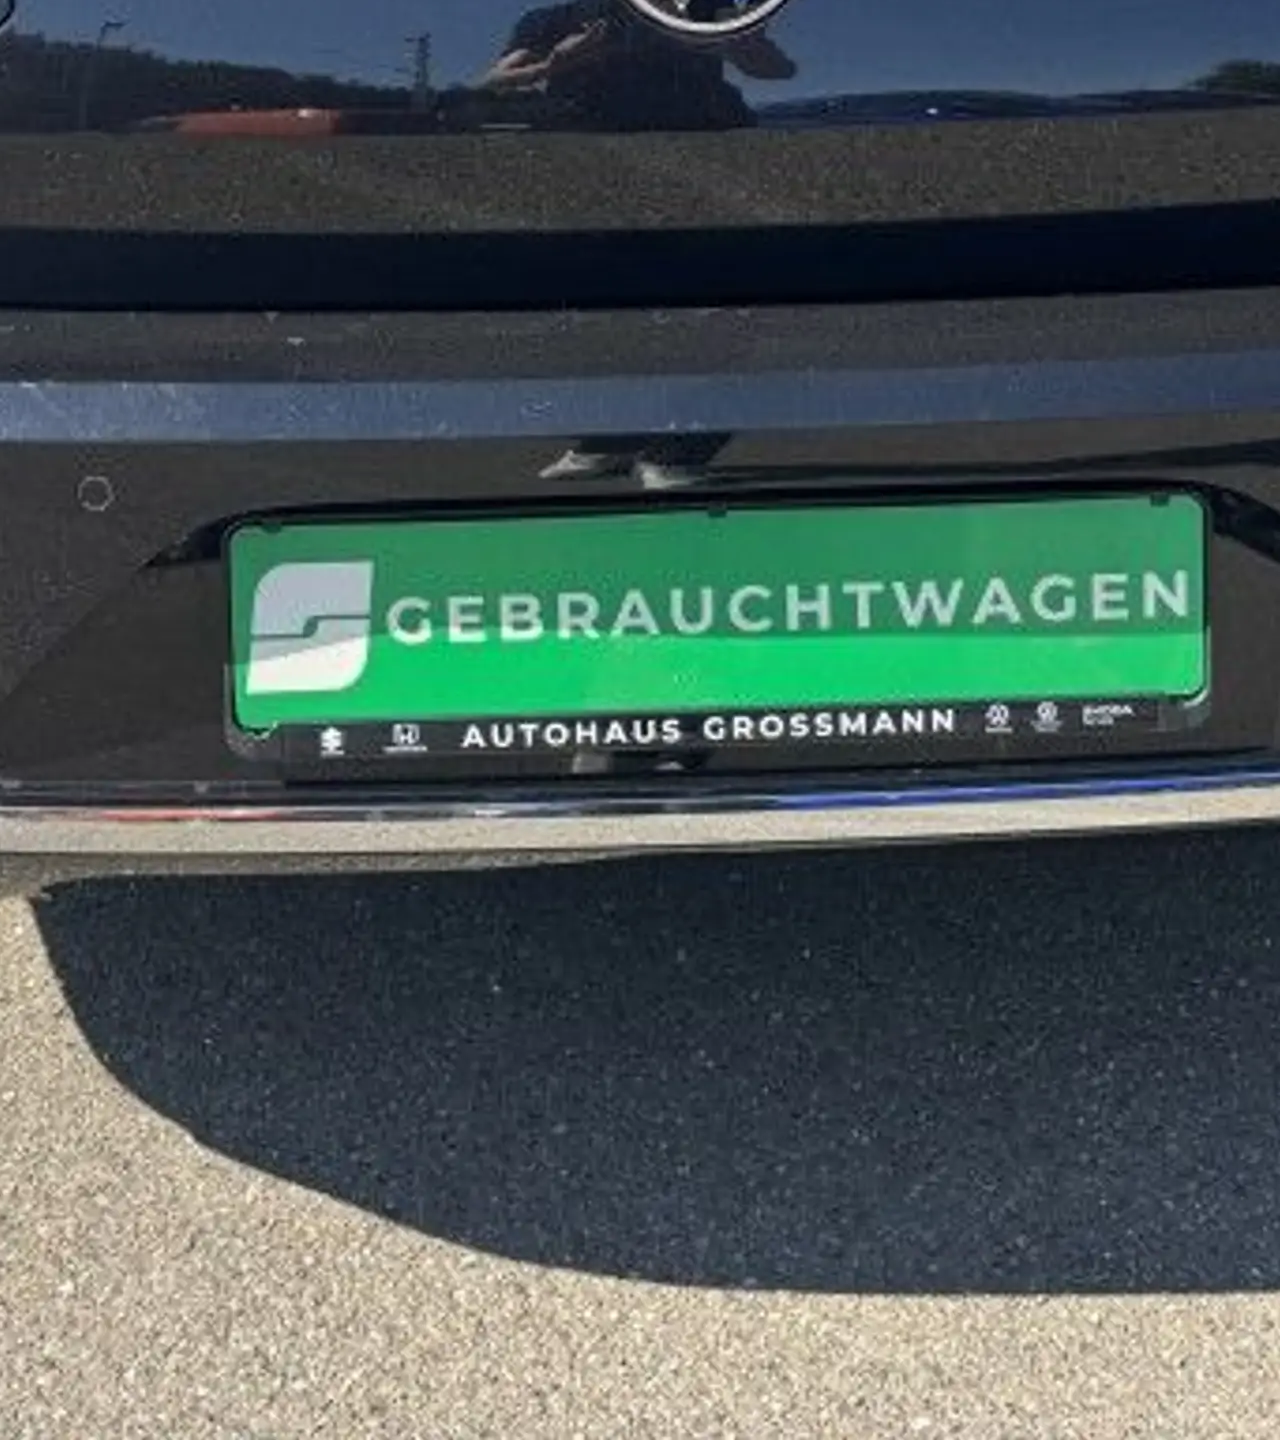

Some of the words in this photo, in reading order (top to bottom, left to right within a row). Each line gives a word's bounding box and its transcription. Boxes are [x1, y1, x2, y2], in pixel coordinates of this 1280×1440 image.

[386, 568, 1191, 646] GEBRAUCHTWAGEN
[460, 718, 682, 749] AUTOHAUS
[703, 708, 957, 741] GROSSMANN
